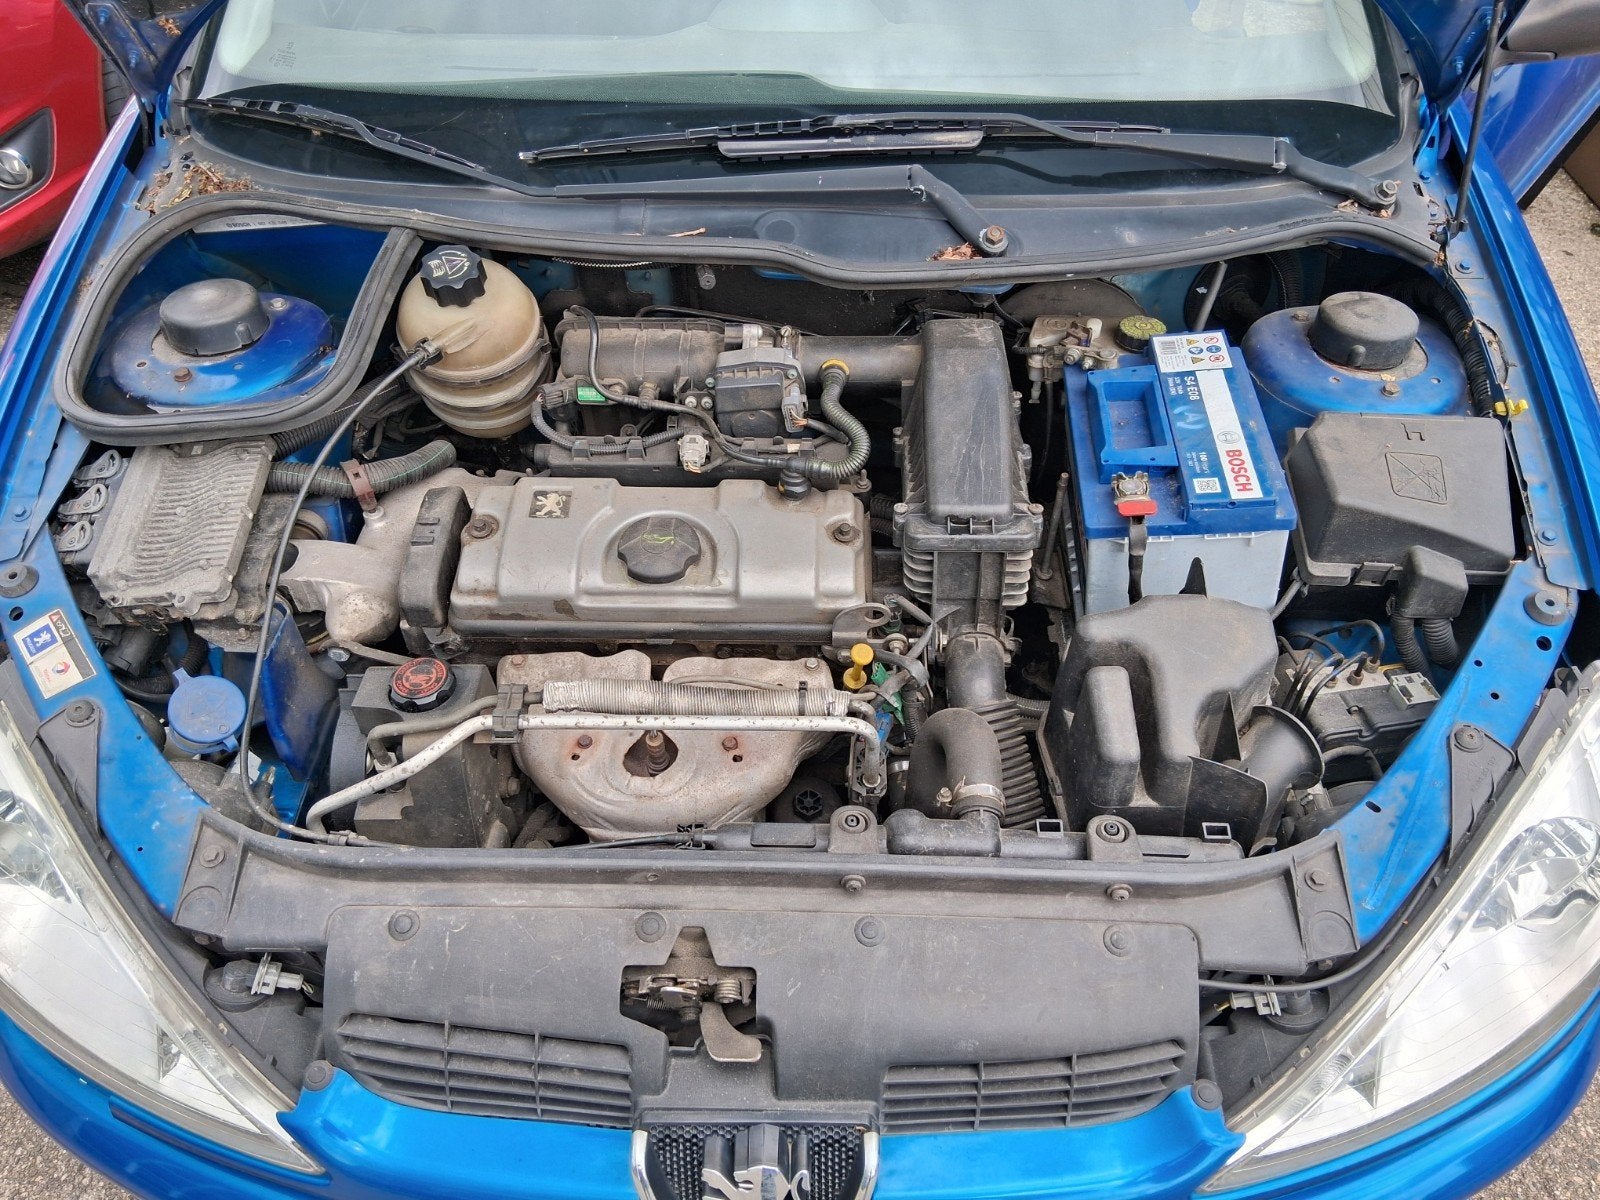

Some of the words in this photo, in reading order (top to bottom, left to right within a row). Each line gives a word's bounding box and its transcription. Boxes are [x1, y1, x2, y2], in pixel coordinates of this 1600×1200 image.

[1184, 375, 1196, 386] S4
[1187, 387, 1200, 401] E08
[1225, 449, 1253, 492] BOSCH
